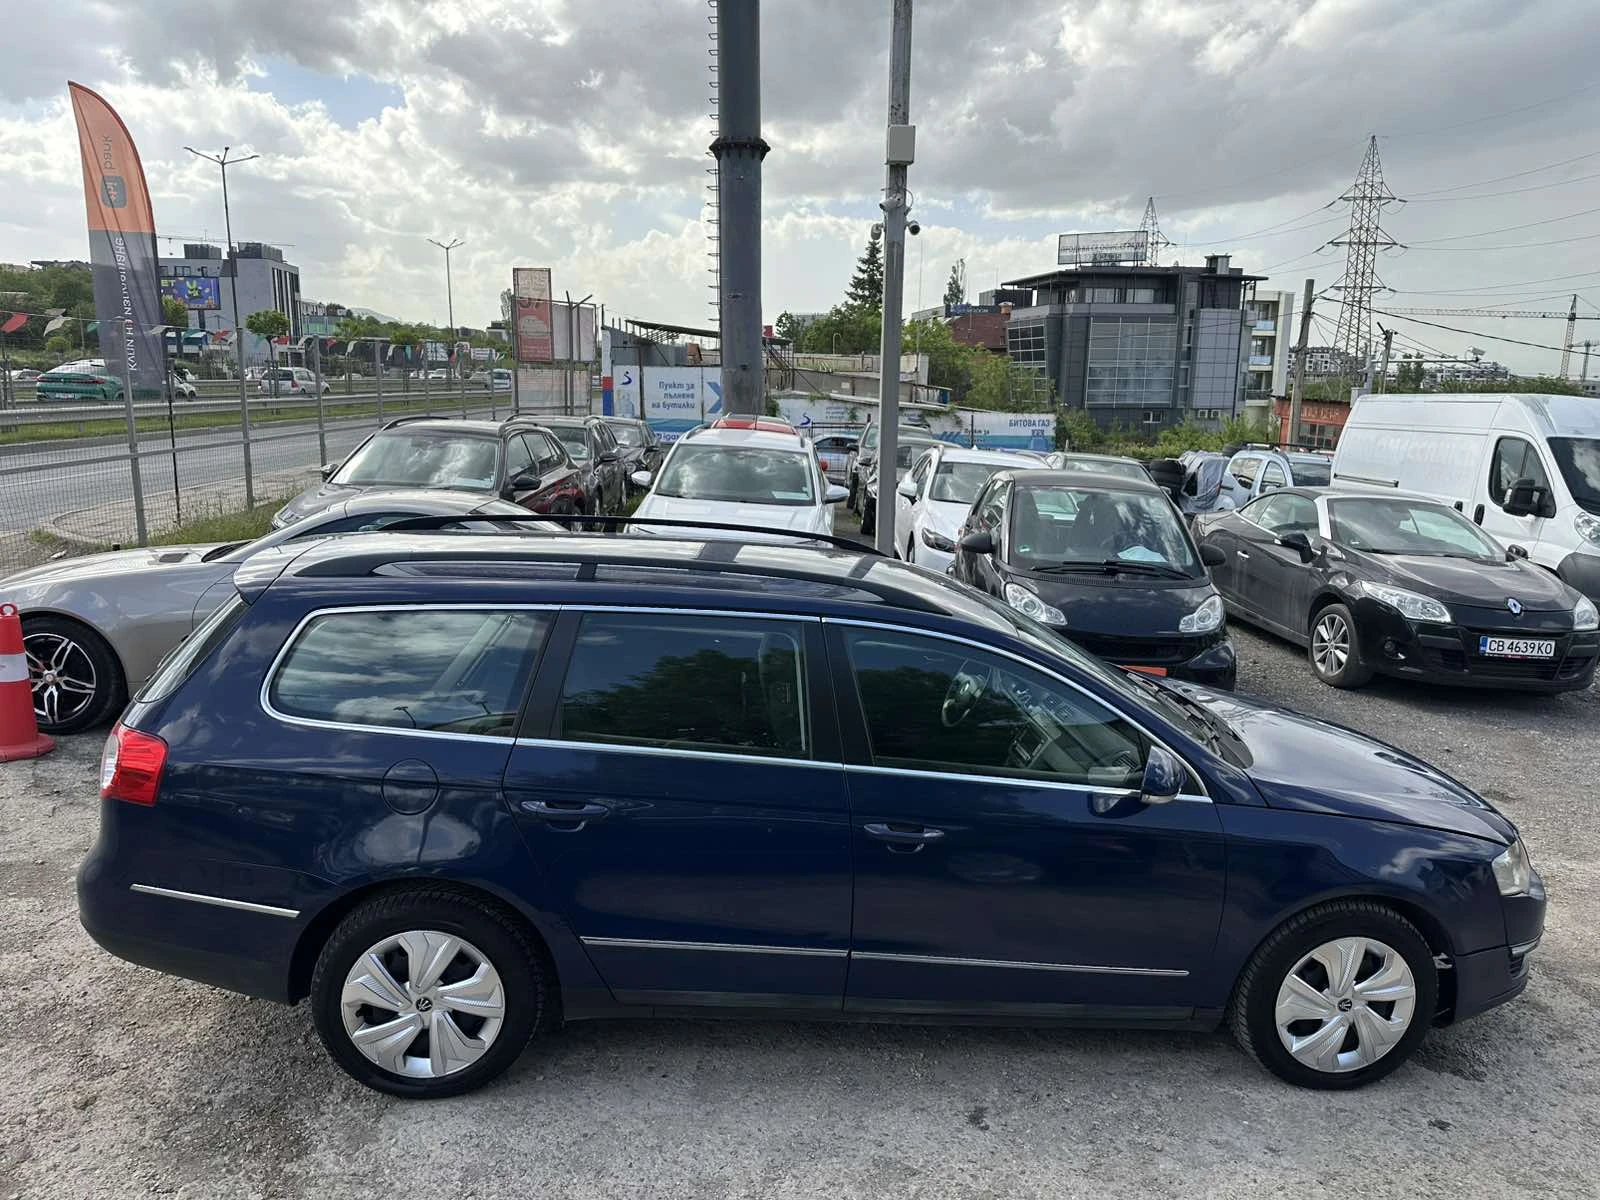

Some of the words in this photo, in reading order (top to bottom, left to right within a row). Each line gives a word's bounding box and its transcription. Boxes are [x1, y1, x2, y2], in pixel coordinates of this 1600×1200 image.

[686, 383, 695, 391] за
[662, 400, 696, 410] бутилки
[1009, 419, 1037, 427] БИТОВА
[1038, 419, 1050, 427] ГАЗ
[1488, 640, 1505, 652] CB
[1507, 641, 1536, 654] 4639
